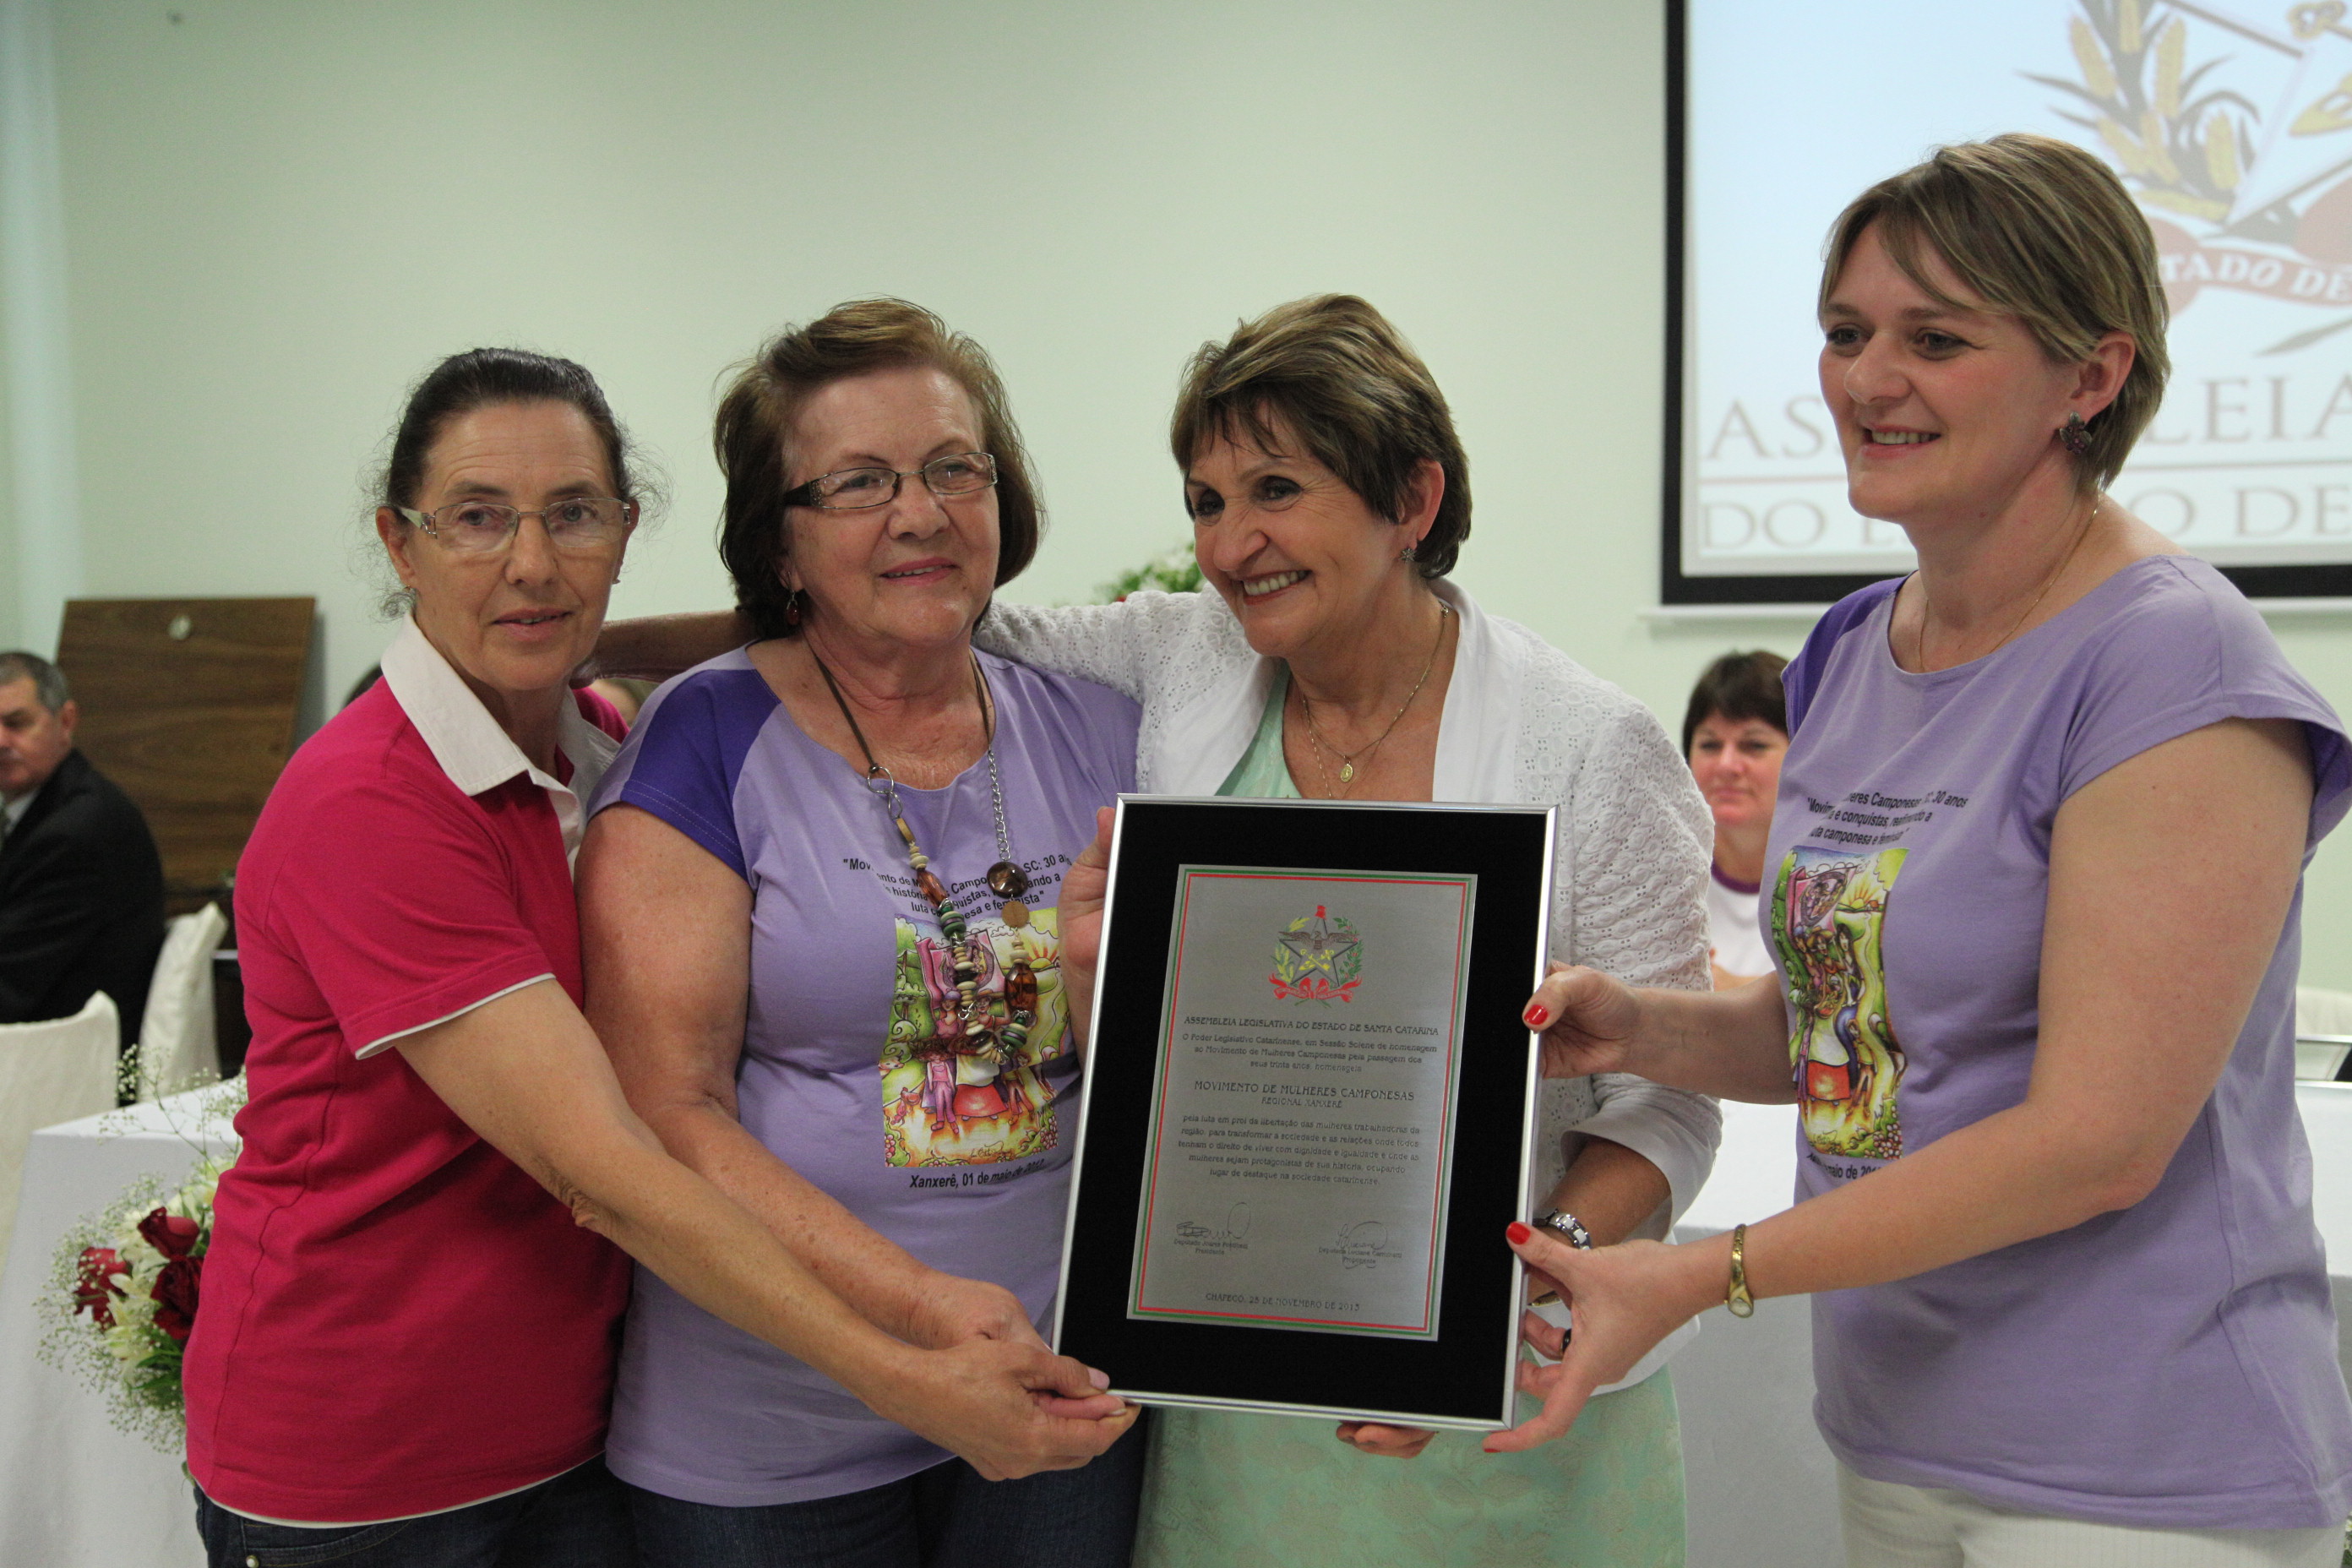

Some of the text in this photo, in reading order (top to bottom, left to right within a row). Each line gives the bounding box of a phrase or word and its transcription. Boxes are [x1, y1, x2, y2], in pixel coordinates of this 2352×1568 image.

[2160, 253, 2283, 288] TADO
[1702, 497, 1827, 549] DO
[2234, 482, 2352, 538] DE
[1944, 797, 1968, 808] anos
[1835, 811, 1841, 820] e
[1841, 811, 1888, 828] conquistas,
[1925, 812, 1933, 822] a
[1823, 827, 1872, 844] camponesa
[899, 876, 911, 885] de
[951, 876, 988, 895] Campo
[1023, 862, 1043, 874] SC:
[1043, 854, 1056, 868] 30
[892, 887, 928, 901] história
[953, 890, 991, 909] quistas,
[1054, 873, 1061, 882] a
[912, 901, 928, 913] luta
[984, 902, 992, 912] e
[1184, 1016, 1439, 1036] ASSEMBLEIA LEGISLATIVA DO ESTADO DE SANTA CATARINA
[1190, 1034, 1212, 1043] Poder
[1214, 1034, 1254, 1043] Legislativo
[1320, 1039, 1346, 1048] Sessão
[1348, 1041, 1375, 1049] Solene
[1389, 1043, 1437, 1053] homenagem
[1206, 1046, 1247, 1055] Movimento
[1249, 1047, 1259, 1055] de
[1261, 1048, 1295, 1058] Mulheres
[1297, 1050, 1346, 1060] Camponesas
[1348, 1053, 1365, 1061] pela
[1367, 1054, 1406, 1064] passagem
[1315, 1064, 1362, 1073] homenageia
[1194, 1081, 1414, 1101] MOVIMENTO DE MULHERES CAMPONESAS
[1261, 1097, 1302, 1106] REGIONAL
[1231, 1116, 1247, 1125] prol
[1260, 1118, 1298, 1128] libertação
[1315, 1121, 1352, 1130] mulheres
[1354, 1123, 1408, 1134] trabalhadoras
[1228, 1130, 1272, 1139] transformar
[1281, 1132, 1320, 1141] sociedade
[1339, 1135, 1373, 1145] relações
[1375, 1138, 1395, 1146] onde
[1178, 1140, 1206, 1149] tenham
[1217, 1141, 1241, 1151] direito
[1243, 1143, 1253, 1152] de
[1255, 1144, 1272, 1152] viver
[1294, 1146, 1331, 1157] dignidade
[1341, 1149, 1379, 1158] igualdade
[1388, 1152, 1407, 1160] onde
[1189, 1153, 1223, 1162] mulheres
[1226, 1156, 1249, 1164] sejam
[1251, 1157, 1302, 1168] protagonistas
[1366, 1164, 1406, 1173] ocupando
[1846, 1164, 1858, 1179] de
[909, 1173, 959, 1189] Xanxerê,
[962, 1173, 973, 1186] 01
[977, 1172, 988, 1184] de
[990, 1169, 1012, 1182] maio
[1210, 1168, 1229, 1177] lugar
[1231, 1168, 1241, 1177] de
[1243, 1169, 1278, 1179] destaque
[1292, 1173, 1331, 1182] sociedade
[1262, 1297, 1272, 1305] DE
[1276, 1298, 1322, 1309] NOVEMBRO
[1325, 1301, 1336, 1309] DE
